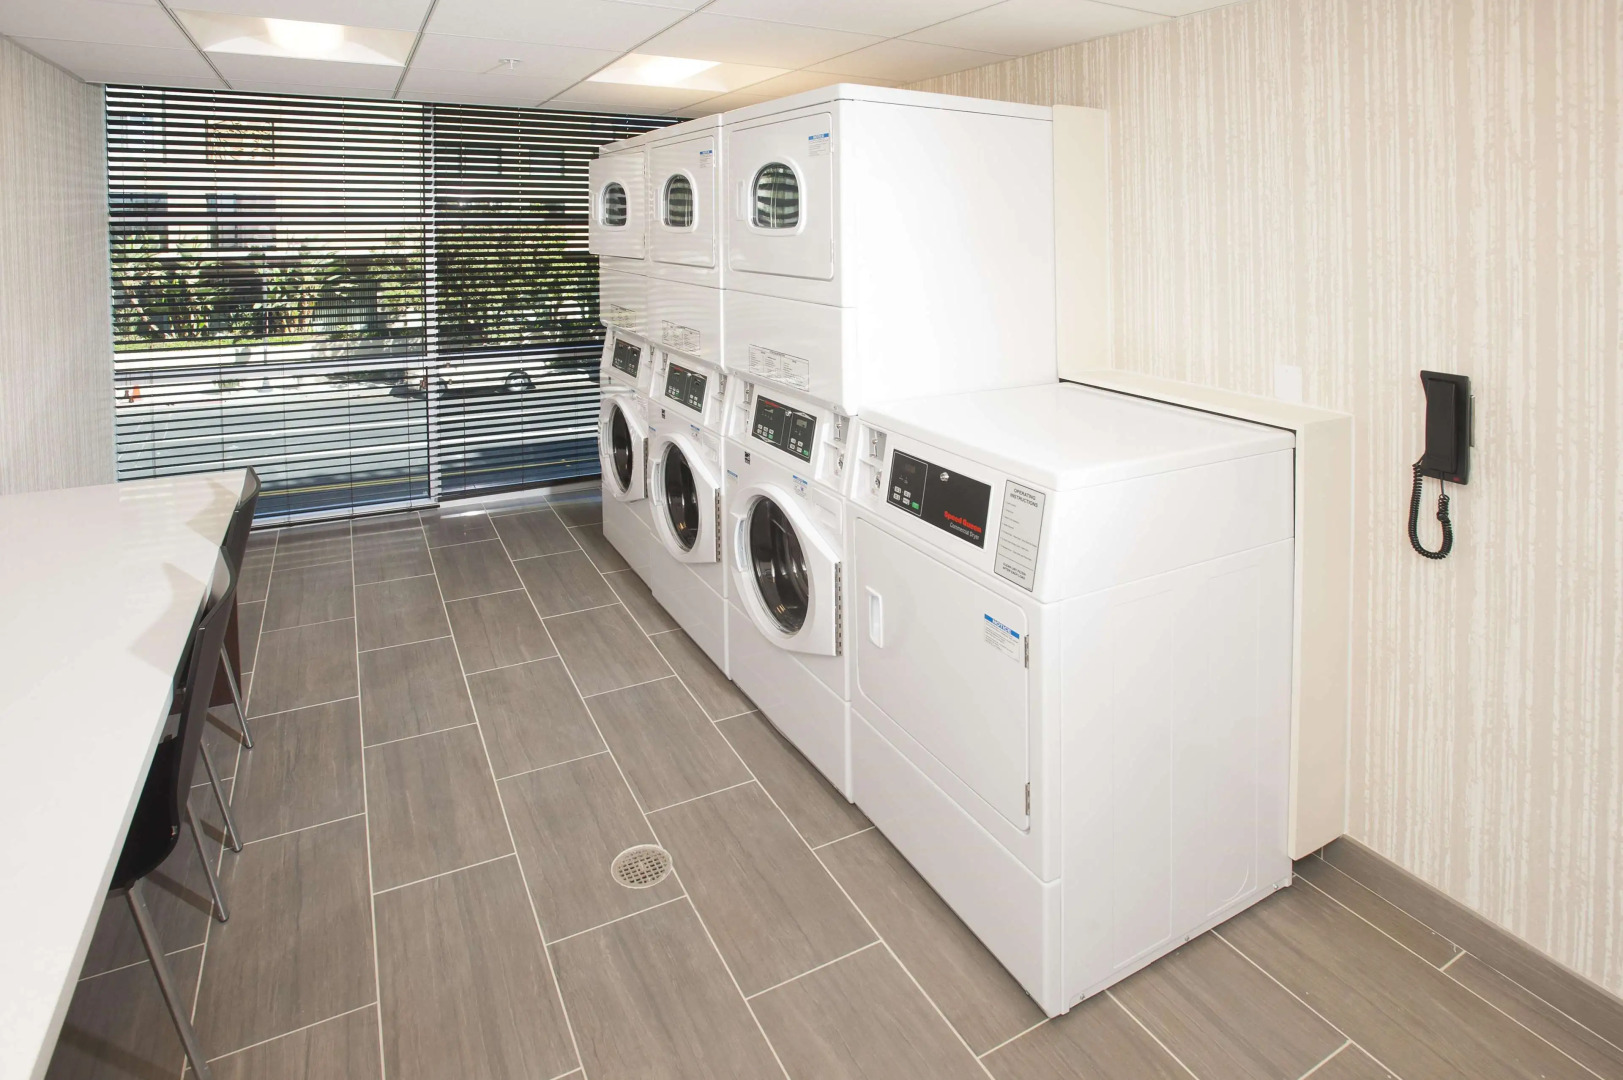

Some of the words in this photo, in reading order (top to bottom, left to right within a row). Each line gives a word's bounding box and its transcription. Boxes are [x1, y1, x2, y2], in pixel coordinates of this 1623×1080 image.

[1010, 493, 1039, 508] INSTRUCTIONS
[1014, 488, 1036, 501] OPERATING
[944, 510, 963, 524] Speed
[962, 518, 982, 533] Queen
[950, 522, 970, 536] Commercial
[992, 617, 1012, 635] NOTICE
